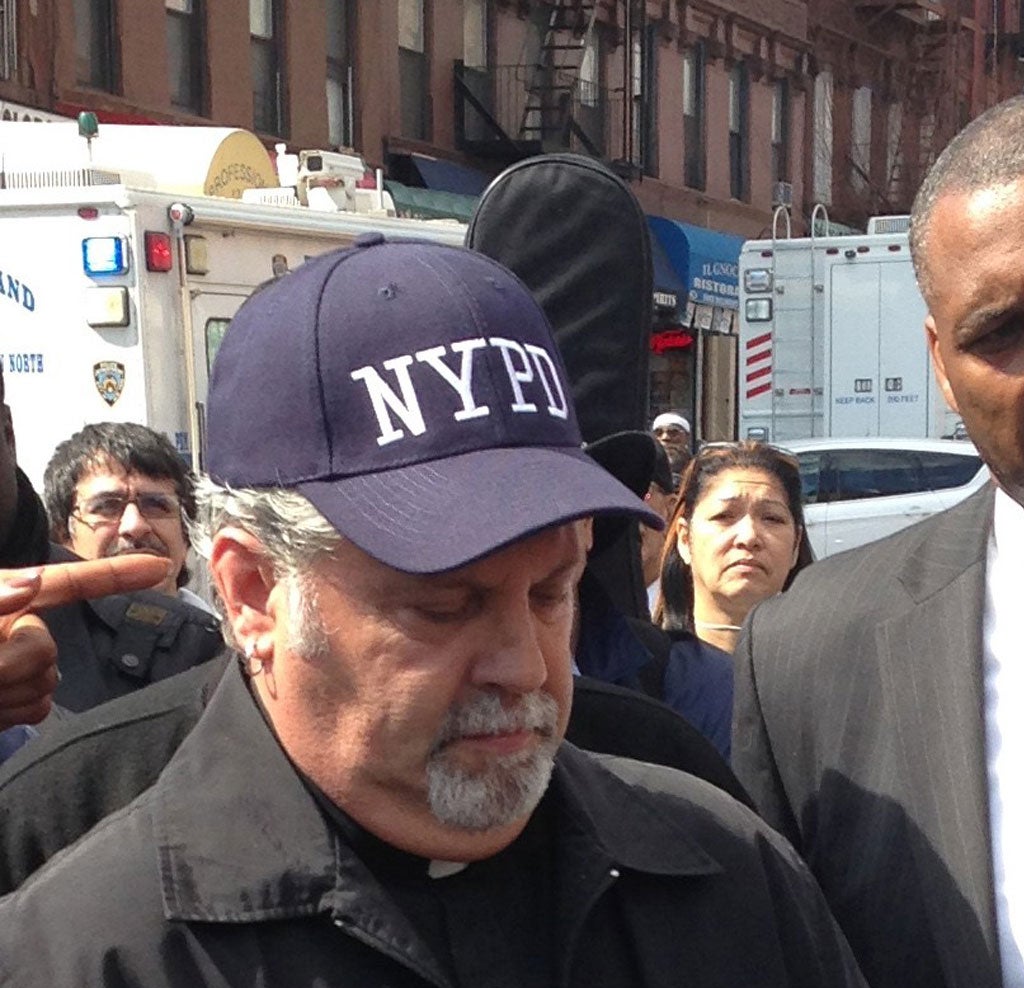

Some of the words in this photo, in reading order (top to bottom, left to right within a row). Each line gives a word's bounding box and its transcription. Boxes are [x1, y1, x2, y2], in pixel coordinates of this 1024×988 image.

[8, 354, 44, 373] NORTH
[350, 337, 569, 447] NYPD
[835, 396, 854, 404] KEEP
[856, 395, 875, 404] BACK
